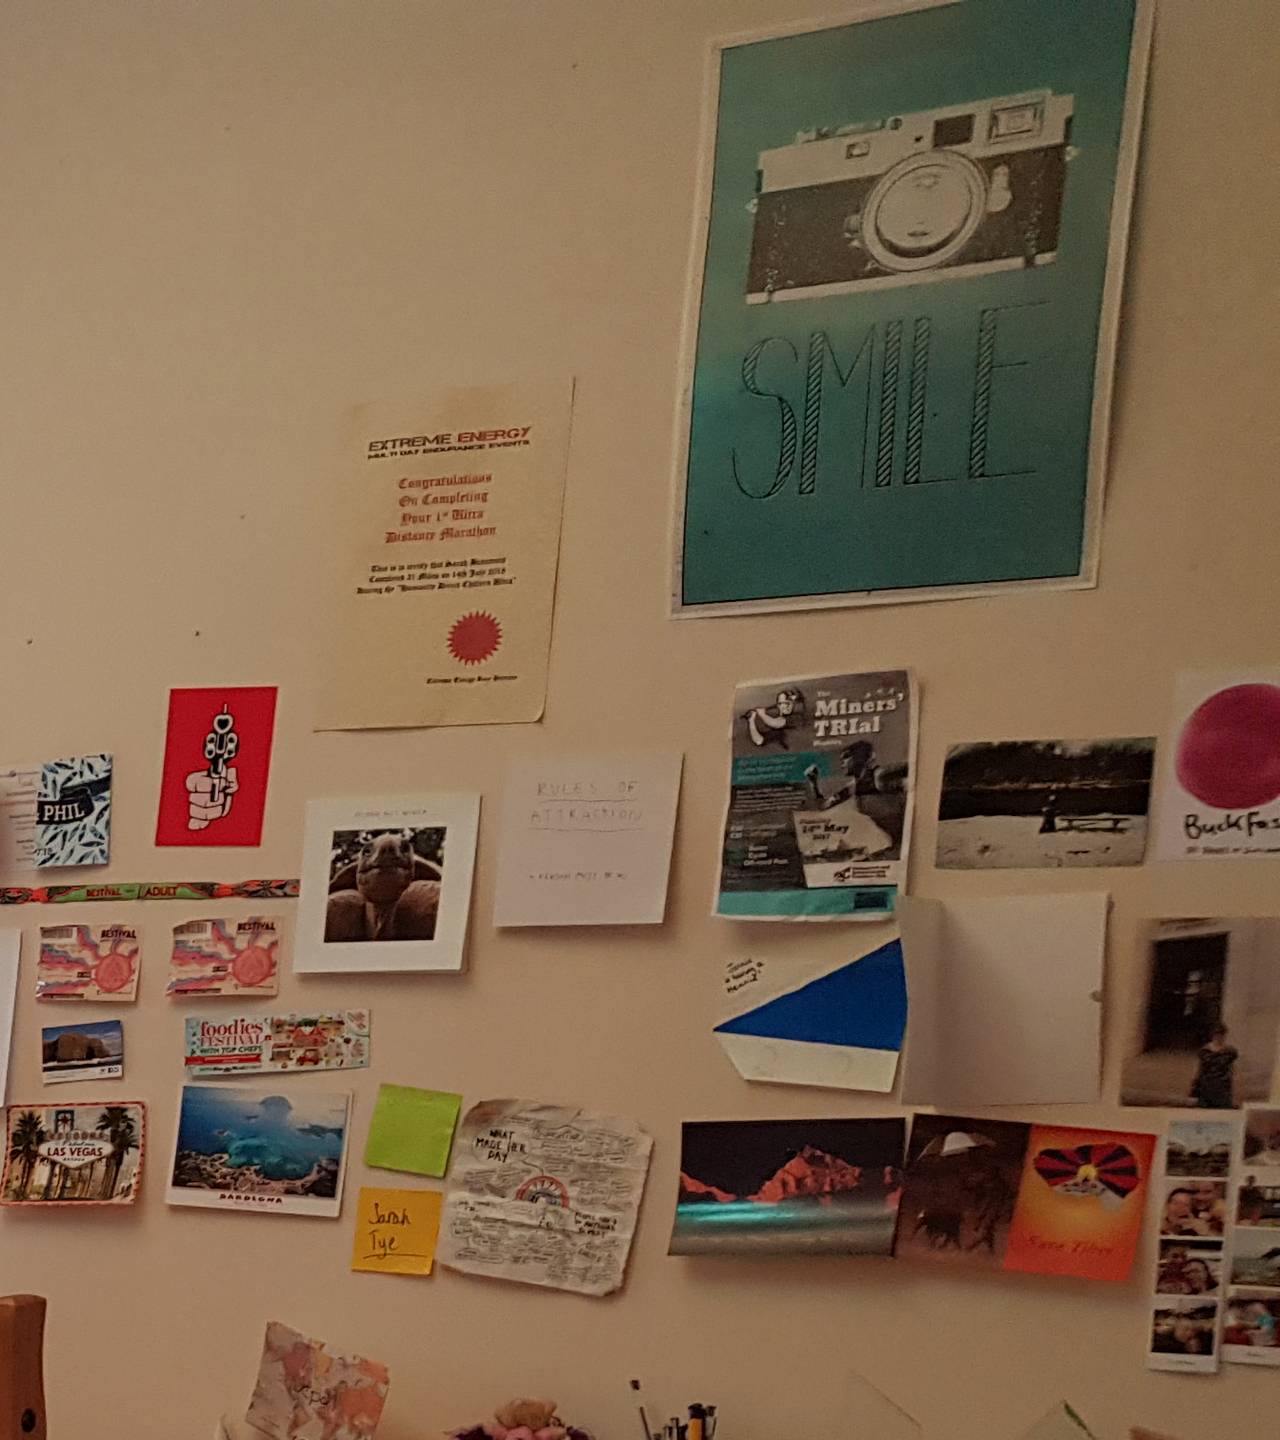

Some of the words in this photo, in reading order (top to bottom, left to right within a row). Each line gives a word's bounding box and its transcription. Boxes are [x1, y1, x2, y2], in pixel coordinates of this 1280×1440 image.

[733, 301, 1051, 499] SMILE
[369, 433, 451, 452] EXTREME
[458, 426, 532, 443] ENERGY
[398, 473, 492, 489] Congratulations
[398, 495, 418, 507] On
[421, 491, 489, 505] Completing
[400, 512, 432, 526] Your
[385, 531, 436, 543] Distance
[440, 525, 496, 541] Marathon
[43, 804, 85, 821] PHIL
[86, 888, 120, 897] BESTIVAL
[145, 886, 178, 897] ADULT
[101, 930, 136, 939] BESTIVAL
[237, 922, 275, 932] BESTIVAL
[200, 1018, 264, 1038] foodies
[200, 1034, 265, 1047] FESTIVAL
[48, 1147, 65, 1156] LAS
[70, 1147, 103, 1157] VEGAS
[487, 1151, 507, 1163] DAY
[369, 1229, 398, 1260] Tye
